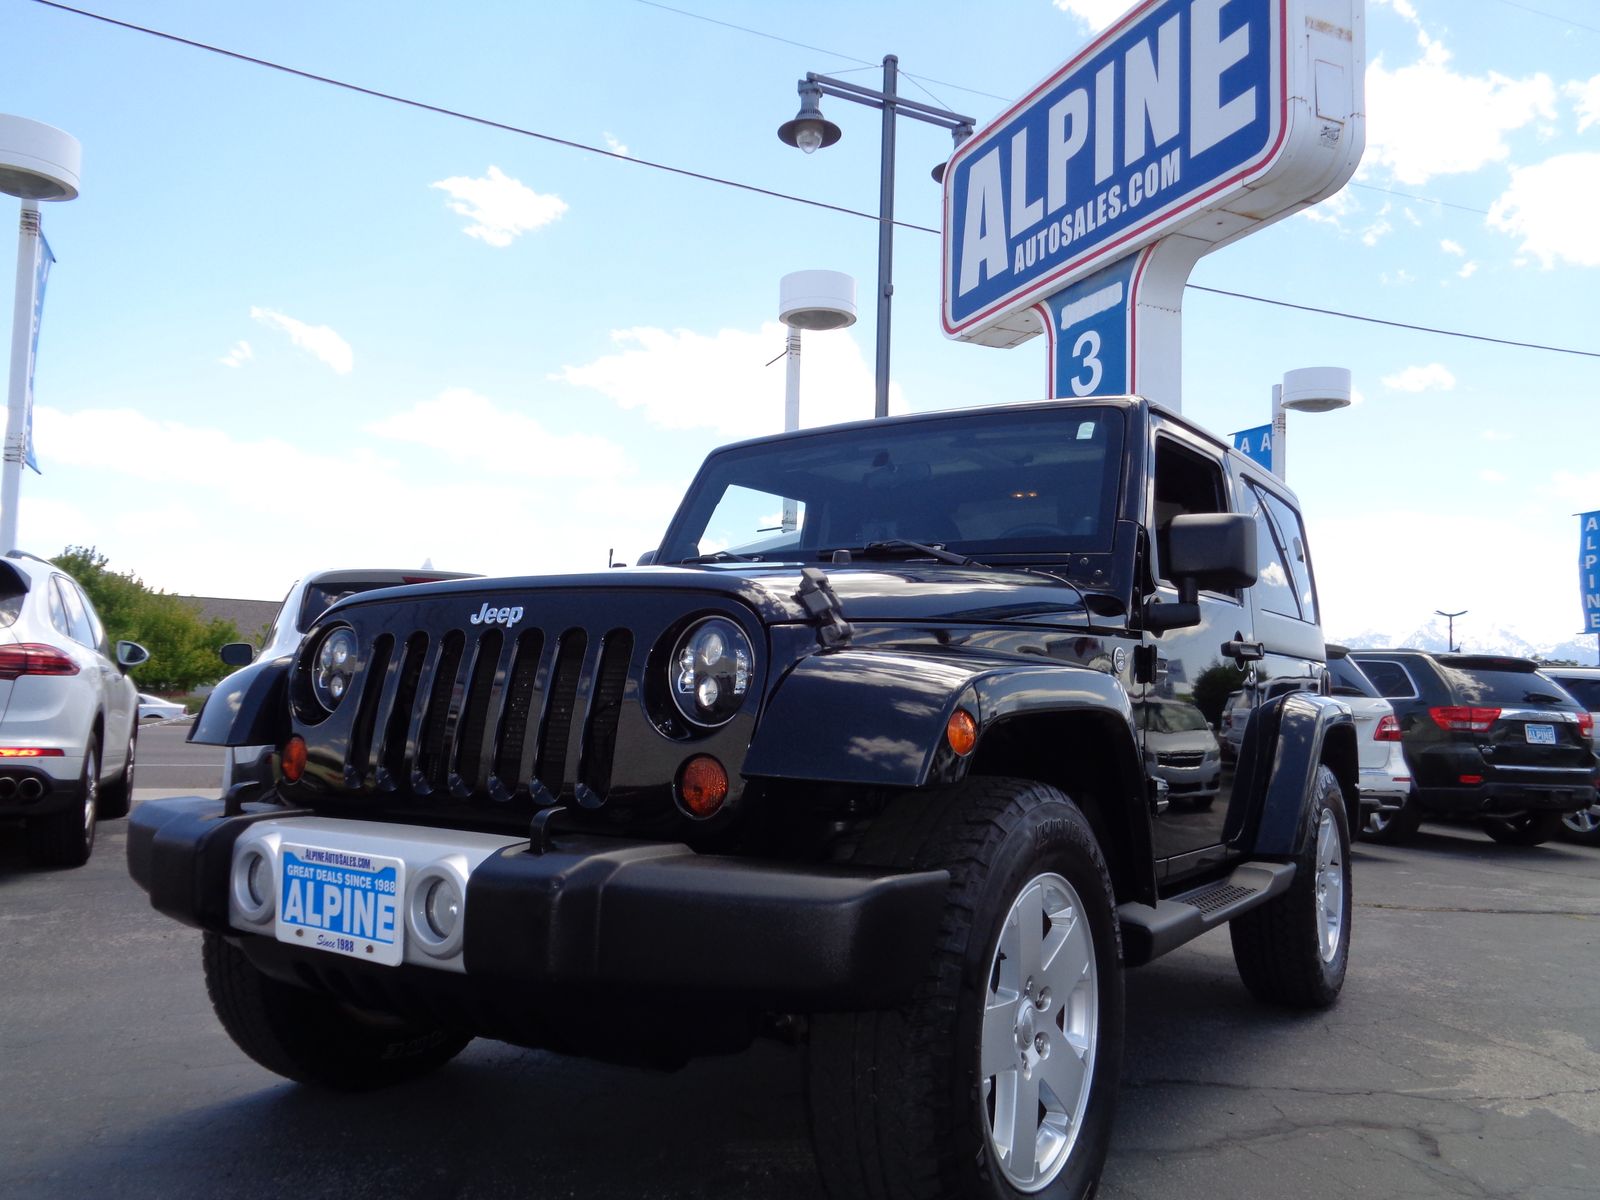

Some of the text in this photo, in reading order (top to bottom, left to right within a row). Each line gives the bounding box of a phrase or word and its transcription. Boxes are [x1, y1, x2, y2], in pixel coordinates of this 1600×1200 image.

[958, 0, 1257, 297] ALPINE
[1013, 148, 1181, 276] AUTOSALES.COM
[1070, 330, 1103, 397] 3
[1585, 517, 1600, 628] ALPINE
[470, 602, 524, 628] Jeep
[283, 878, 395, 942] ALPINE
[287, 864, 396, 893] GREAT DEALS SINCE 1988
[316, 934, 354, 952] Since 1988
